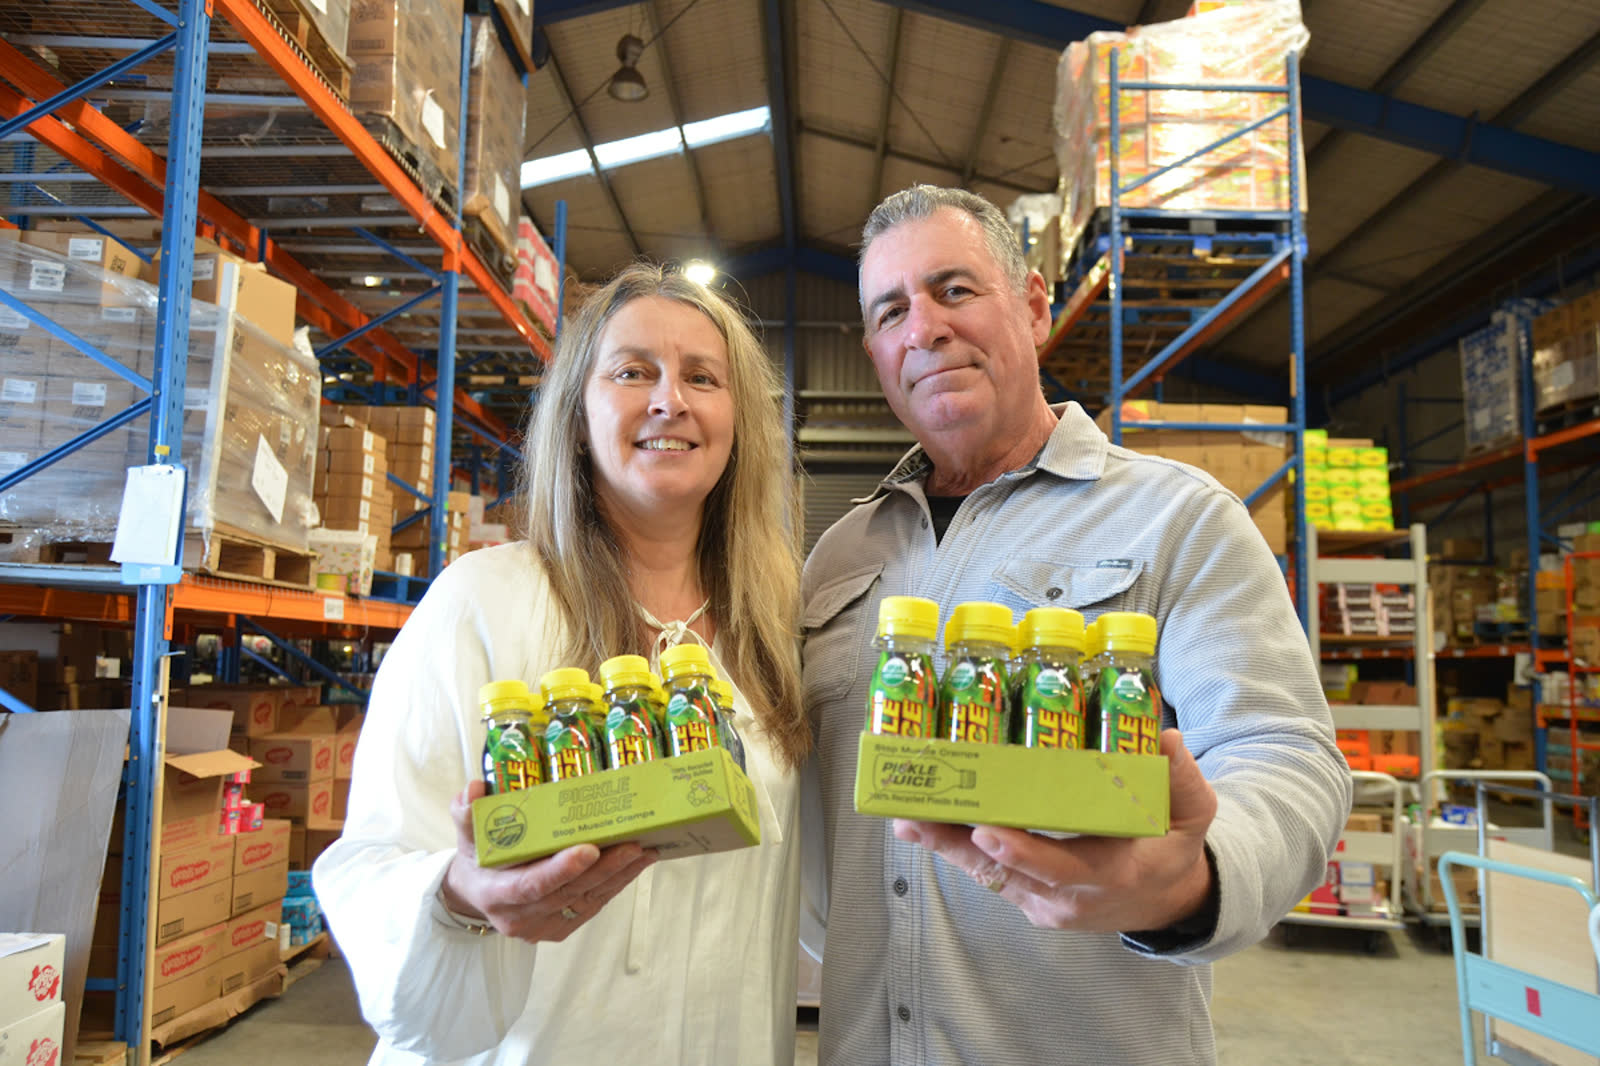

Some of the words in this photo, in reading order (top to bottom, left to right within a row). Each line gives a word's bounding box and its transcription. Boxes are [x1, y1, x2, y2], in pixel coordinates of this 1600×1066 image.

[881, 760, 938, 776] PICKLE
[880, 773, 937, 789] JUICE
[557, 775, 630, 808] PICKLE
[560, 793, 634, 824] JUICE
[615, 809, 656, 825] Cramps
